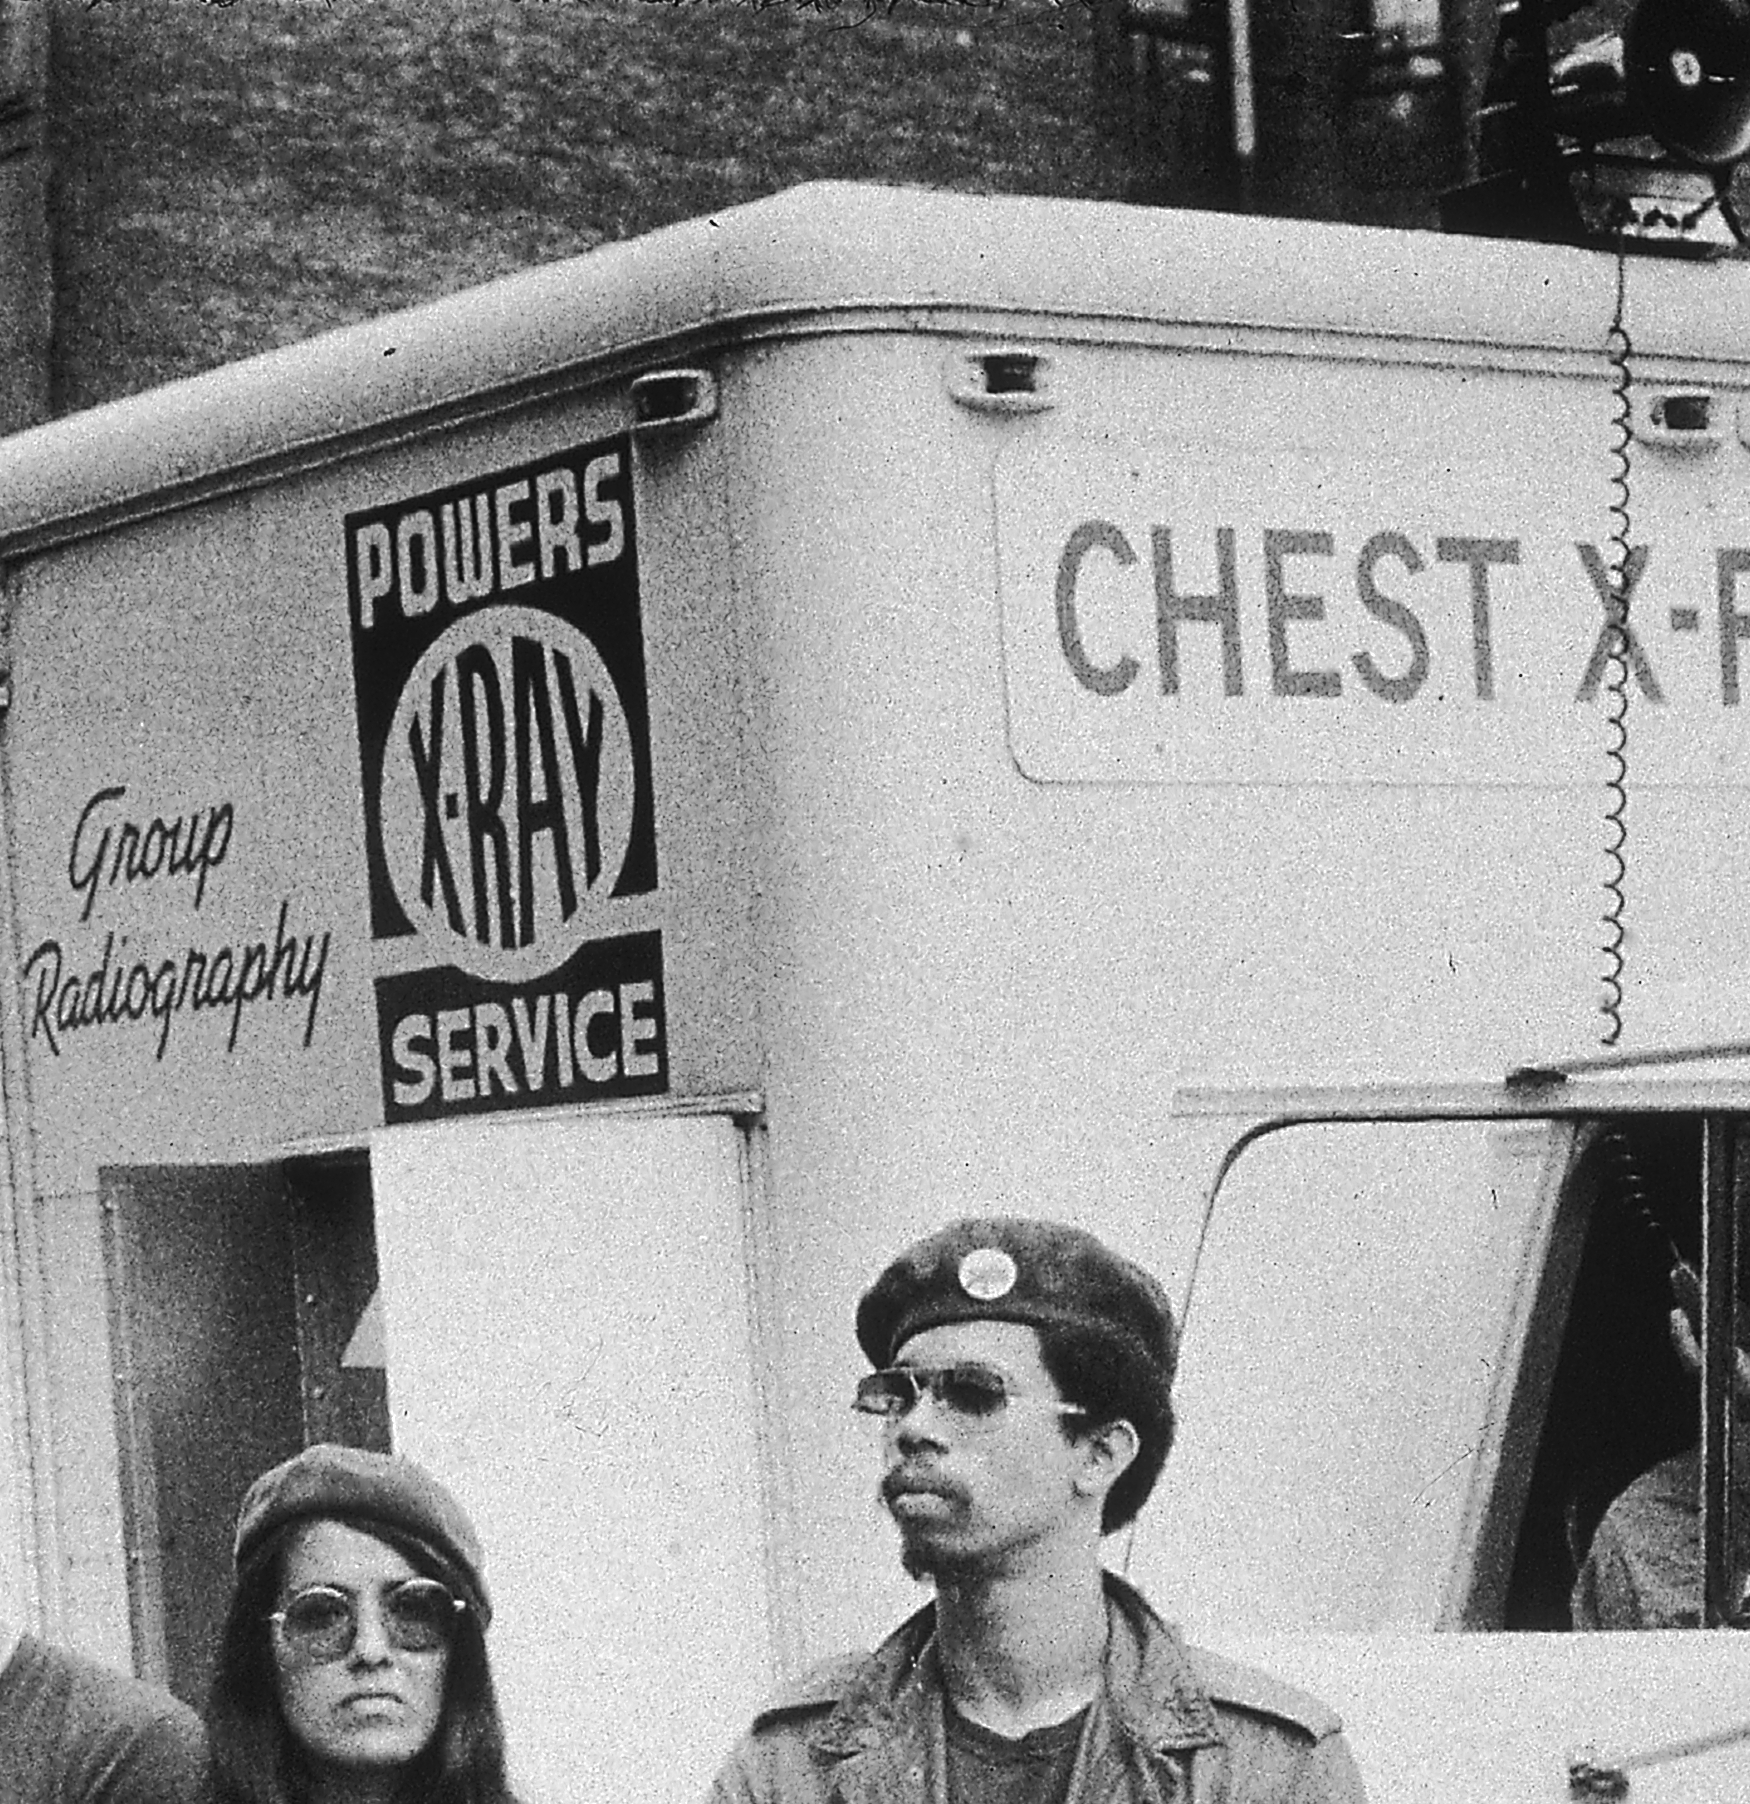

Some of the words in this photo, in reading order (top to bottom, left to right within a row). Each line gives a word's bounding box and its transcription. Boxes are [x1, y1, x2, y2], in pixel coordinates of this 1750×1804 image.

[355, 453, 625, 628] POWERS
[1054, 519, 1520, 701] CHEST
[68, 785, 234, 922] Group
[407, 636, 603, 950] X-RAY
[23, 901, 331, 1062] Radiography
[390, 980, 660, 1105] SERVICE
